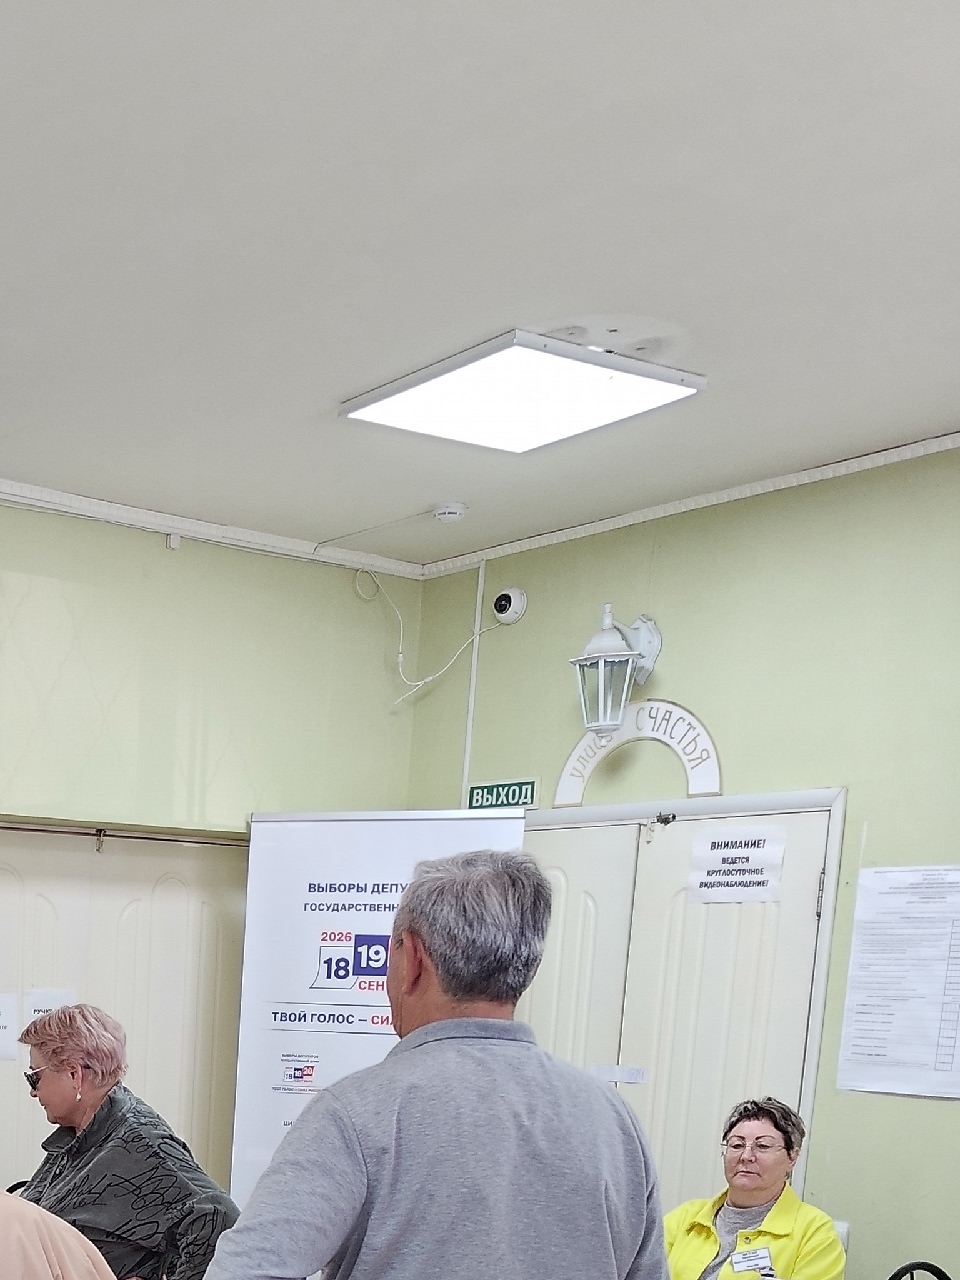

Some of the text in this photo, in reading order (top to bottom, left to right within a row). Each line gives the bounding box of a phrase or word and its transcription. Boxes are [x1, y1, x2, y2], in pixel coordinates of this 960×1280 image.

[472, 784, 532, 807] ВЫХОД
[710, 839, 766, 850] ВНИМАНИЕ!
[721, 856, 750, 865] ВЕДЕТСЯ
[706, 868, 764, 877] КРУГЛОСУТОЧНОЕ
[308, 883, 408, 895] ВЫБОРЫ ДЕПУ
[699, 880, 769, 889] ВИДЕОНАБЛЮДЕНИЕ!
[303, 903, 400, 913] ГОСУДАРСТВЕНН
[320, 931, 352, 942] 2026
[323, 944, 387, 980] 18 19
[358, 980, 385, 991] СЕН
[271, 1010, 307, 1023] ТВОЙ
[310, 1013, 355, 1024] ГОЛОС
[371, 1015, 393, 1026] СИ
